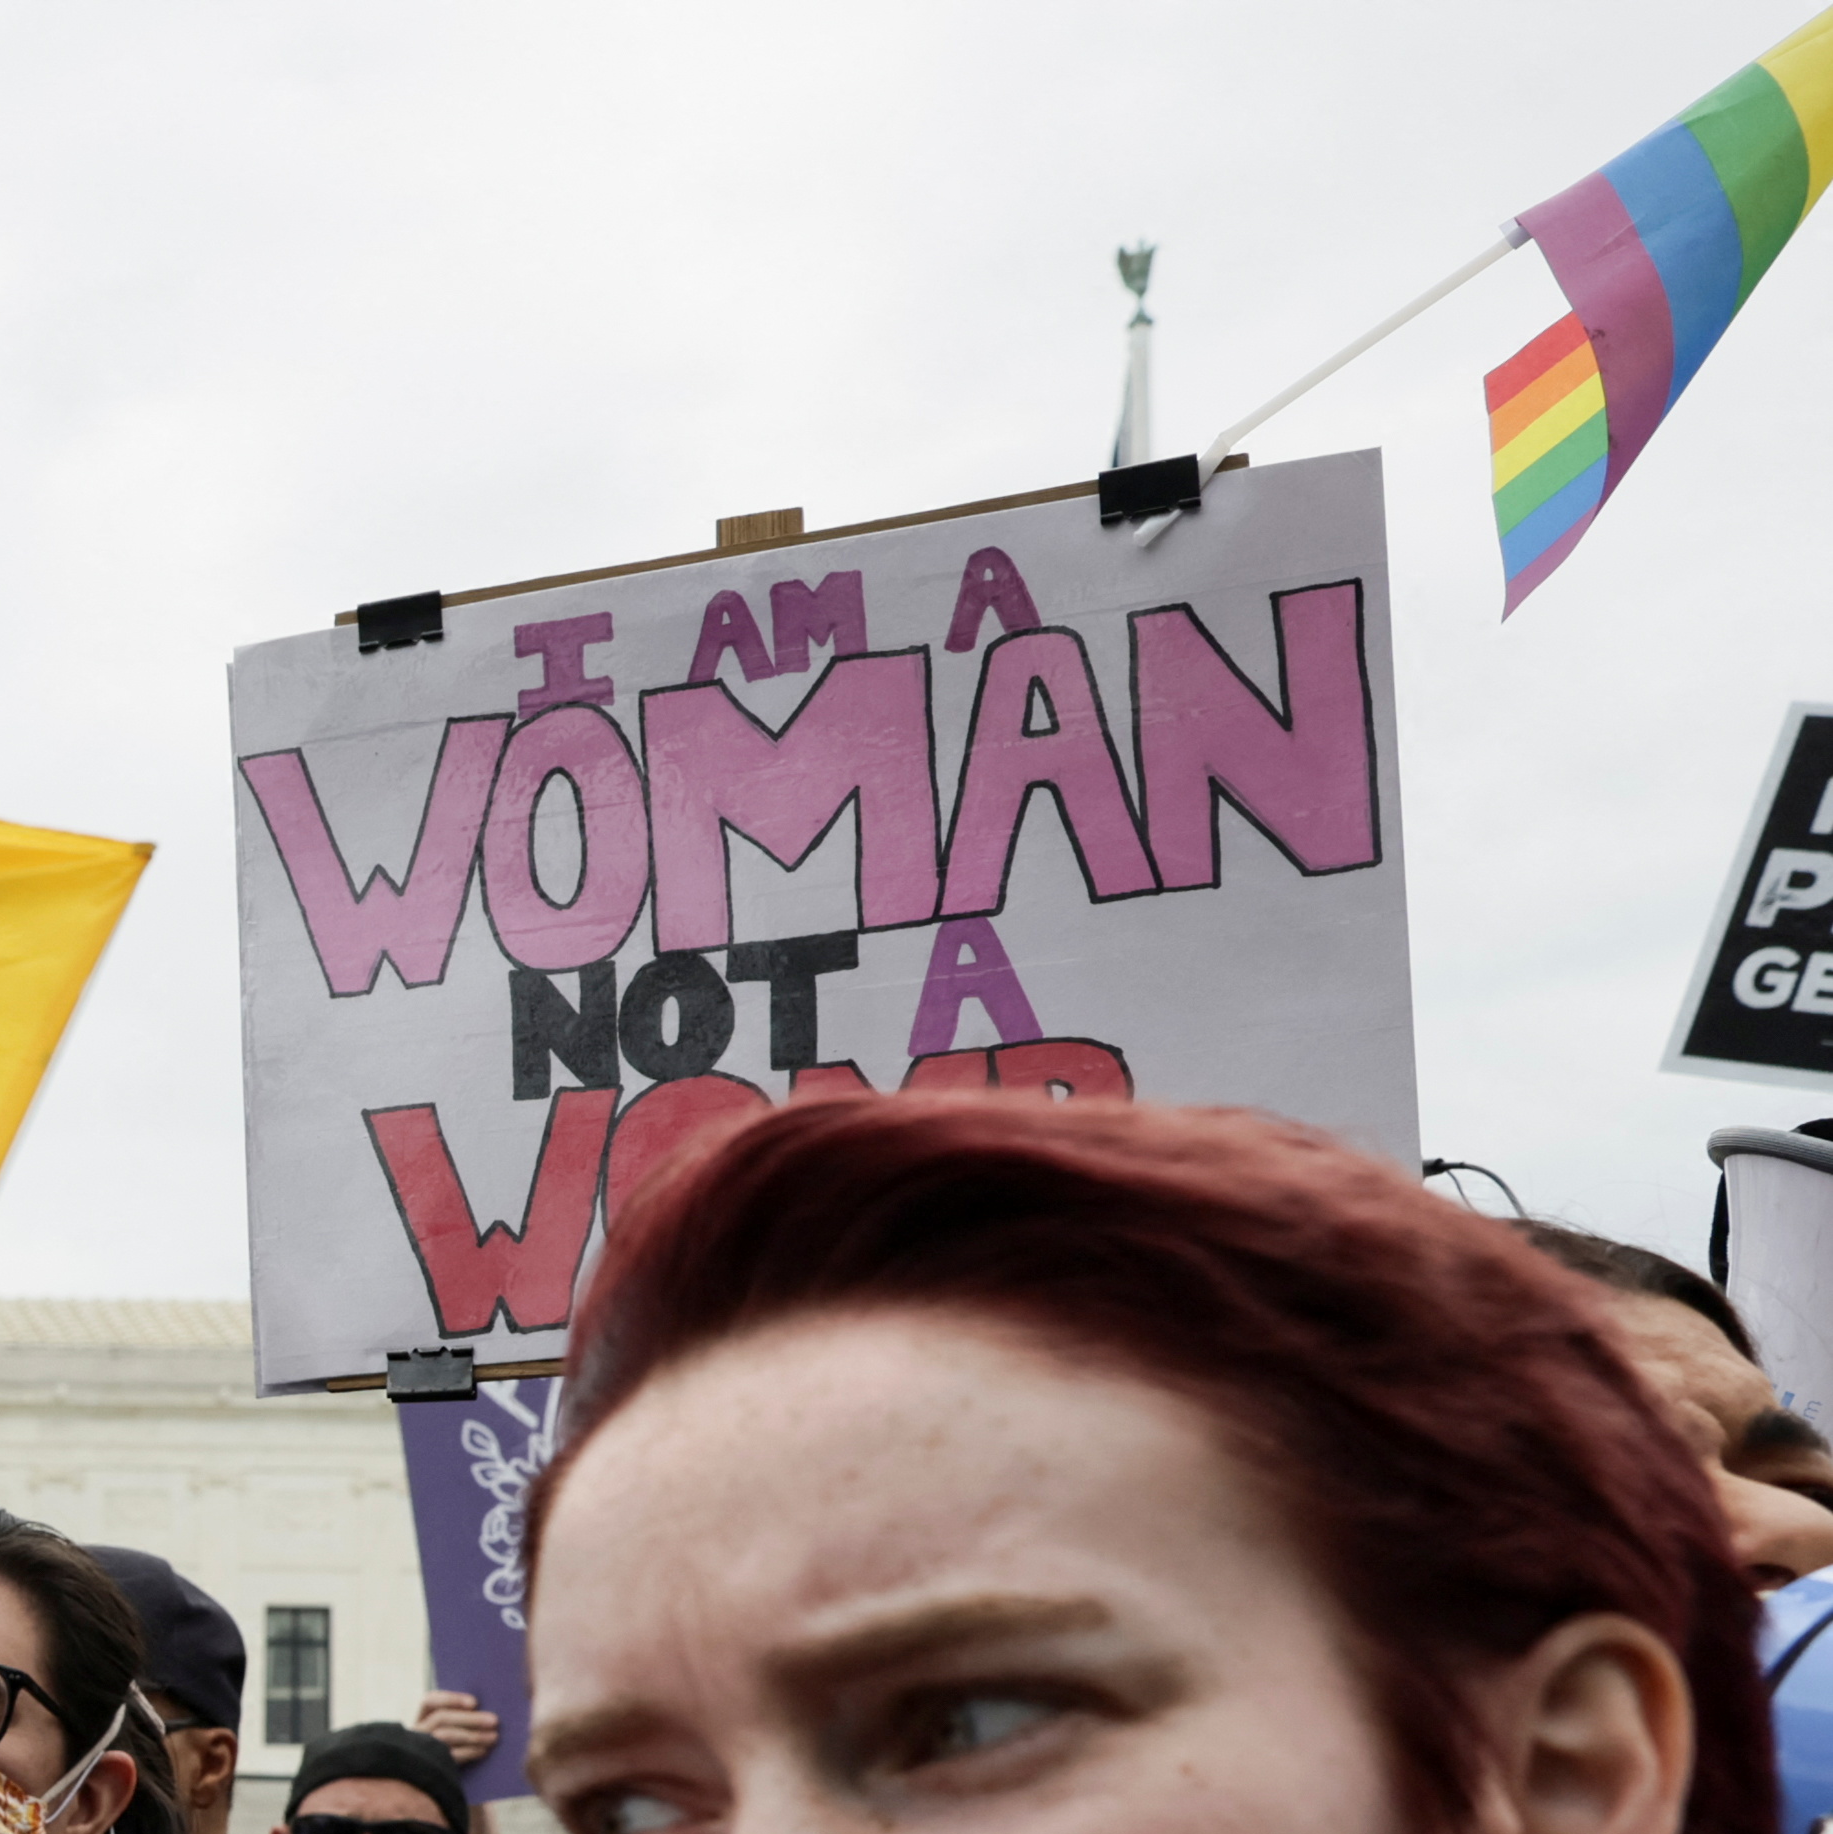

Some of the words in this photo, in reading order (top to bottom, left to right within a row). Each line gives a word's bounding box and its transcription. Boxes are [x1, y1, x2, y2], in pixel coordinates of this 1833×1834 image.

[512, 611, 615, 721] I
[685, 568, 867, 687] AM
[942, 545, 1044, 654] A
[237, 577, 1383, 1000] WOMAN
[509, 928, 859, 1102] NOT
[906, 915, 1046, 1059] A
